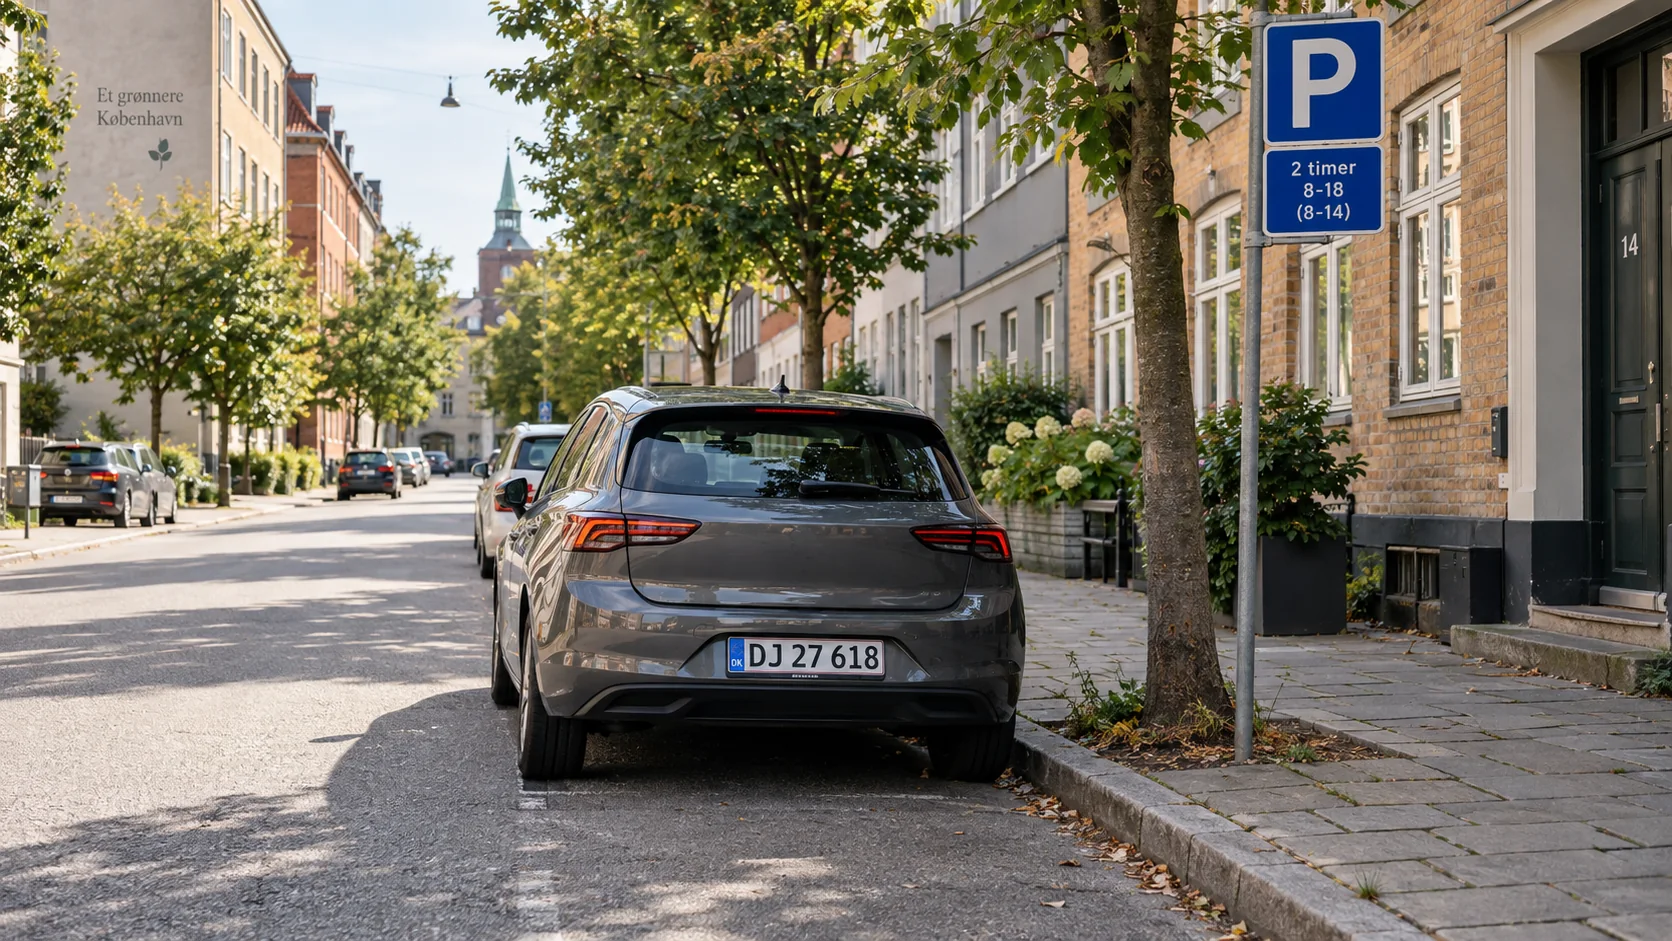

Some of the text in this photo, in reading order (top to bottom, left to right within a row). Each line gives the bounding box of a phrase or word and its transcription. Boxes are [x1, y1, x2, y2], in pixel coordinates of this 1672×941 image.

[1292, 38, 1357, 129] P
[97, 87, 184, 107] Et grønnere
[97, 110, 184, 126] København
[1291, 160, 1357, 177] 2 timer
[1303, 182, 1344, 198] 8-18
[1296, 202, 1351, 222] (8-14)
[1621, 232, 1639, 259] 14
[731, 658, 743, 667] DK
[749, 643, 879, 670] DJ 27 618
